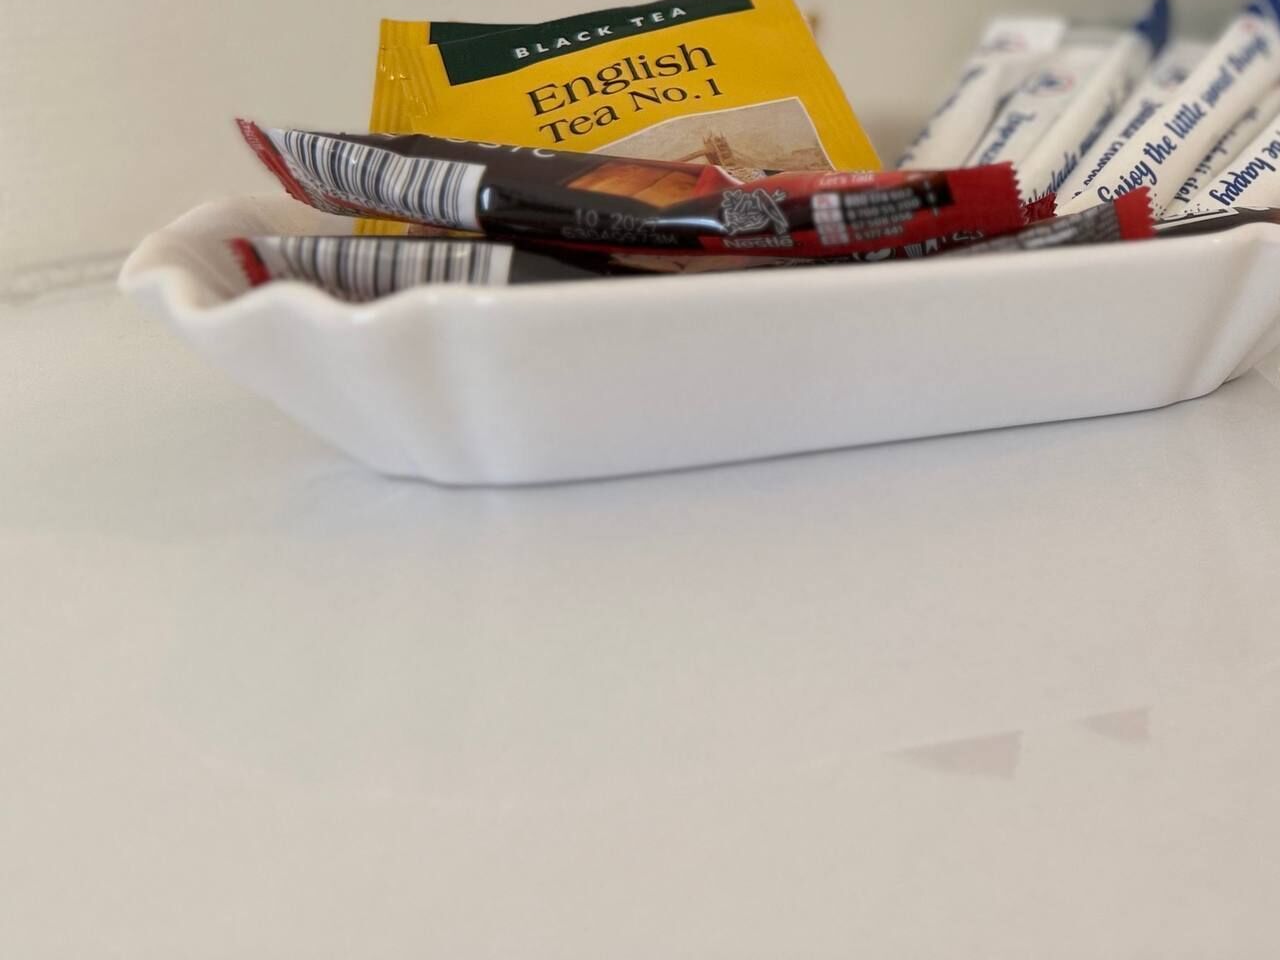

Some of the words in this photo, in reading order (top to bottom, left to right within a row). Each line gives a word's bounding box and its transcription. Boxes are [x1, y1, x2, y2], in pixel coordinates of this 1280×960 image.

[514, 24, 614, 59] BLACK
[630, 7, 688, 27] TEA
[525, 43, 717, 117] English
[538, 103, 621, 144] Tea
[1097, 160, 1158, 204] Enjoy
[1143, 135, 1178, 165] the
[1164, 101, 1206, 139] little
[1208, 156, 1277, 206] happy
